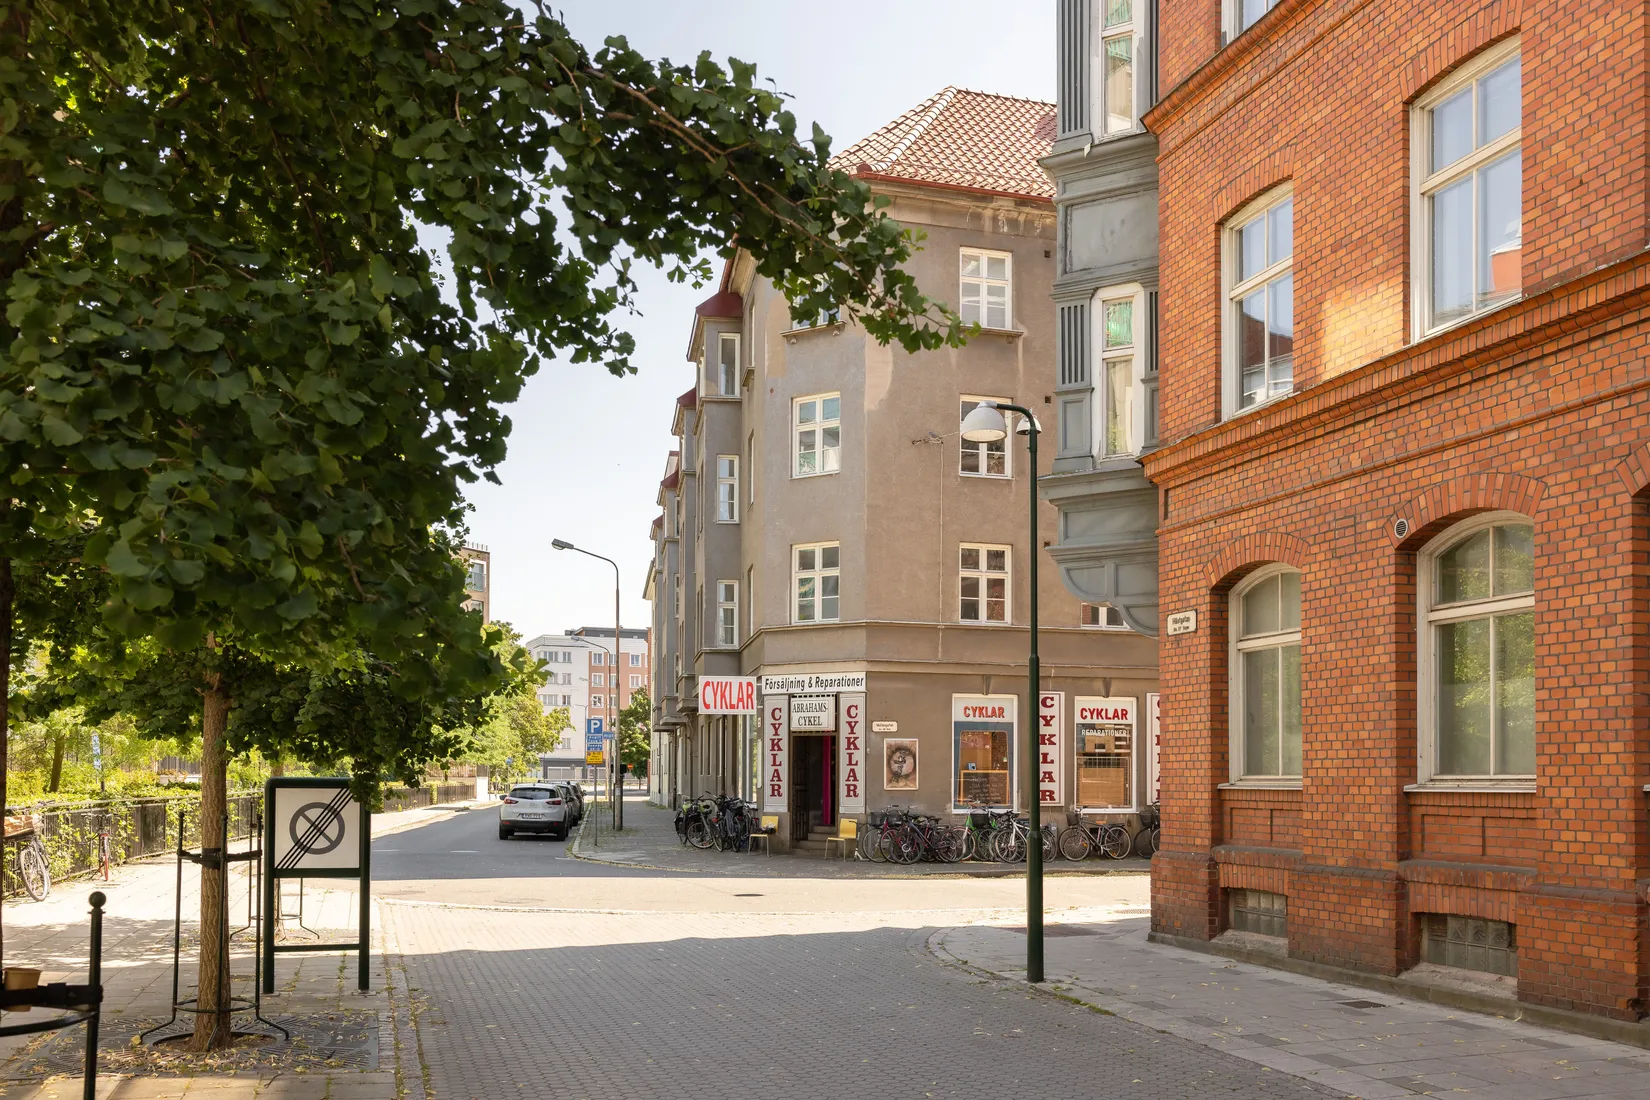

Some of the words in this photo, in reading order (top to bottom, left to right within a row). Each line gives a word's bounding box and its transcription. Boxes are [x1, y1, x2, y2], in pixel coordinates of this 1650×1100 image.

[764, 677, 805, 692] Försäljning
[808, 676, 813, 688] &
[815, 675, 864, 690] Reparationer
[702, 680, 754, 710] CYKLAR
[963, 705, 1005, 718] CYKLAR
[1080, 707, 1128, 720] CYKLAR
[590, 719, 601, 733] P
[798, 716, 822, 726] CYKEL
[769, 707, 783, 797] CYKLAR
[845, 704, 860, 798] CYKLAR
[1039, 696, 1057, 801] CYKLAR
